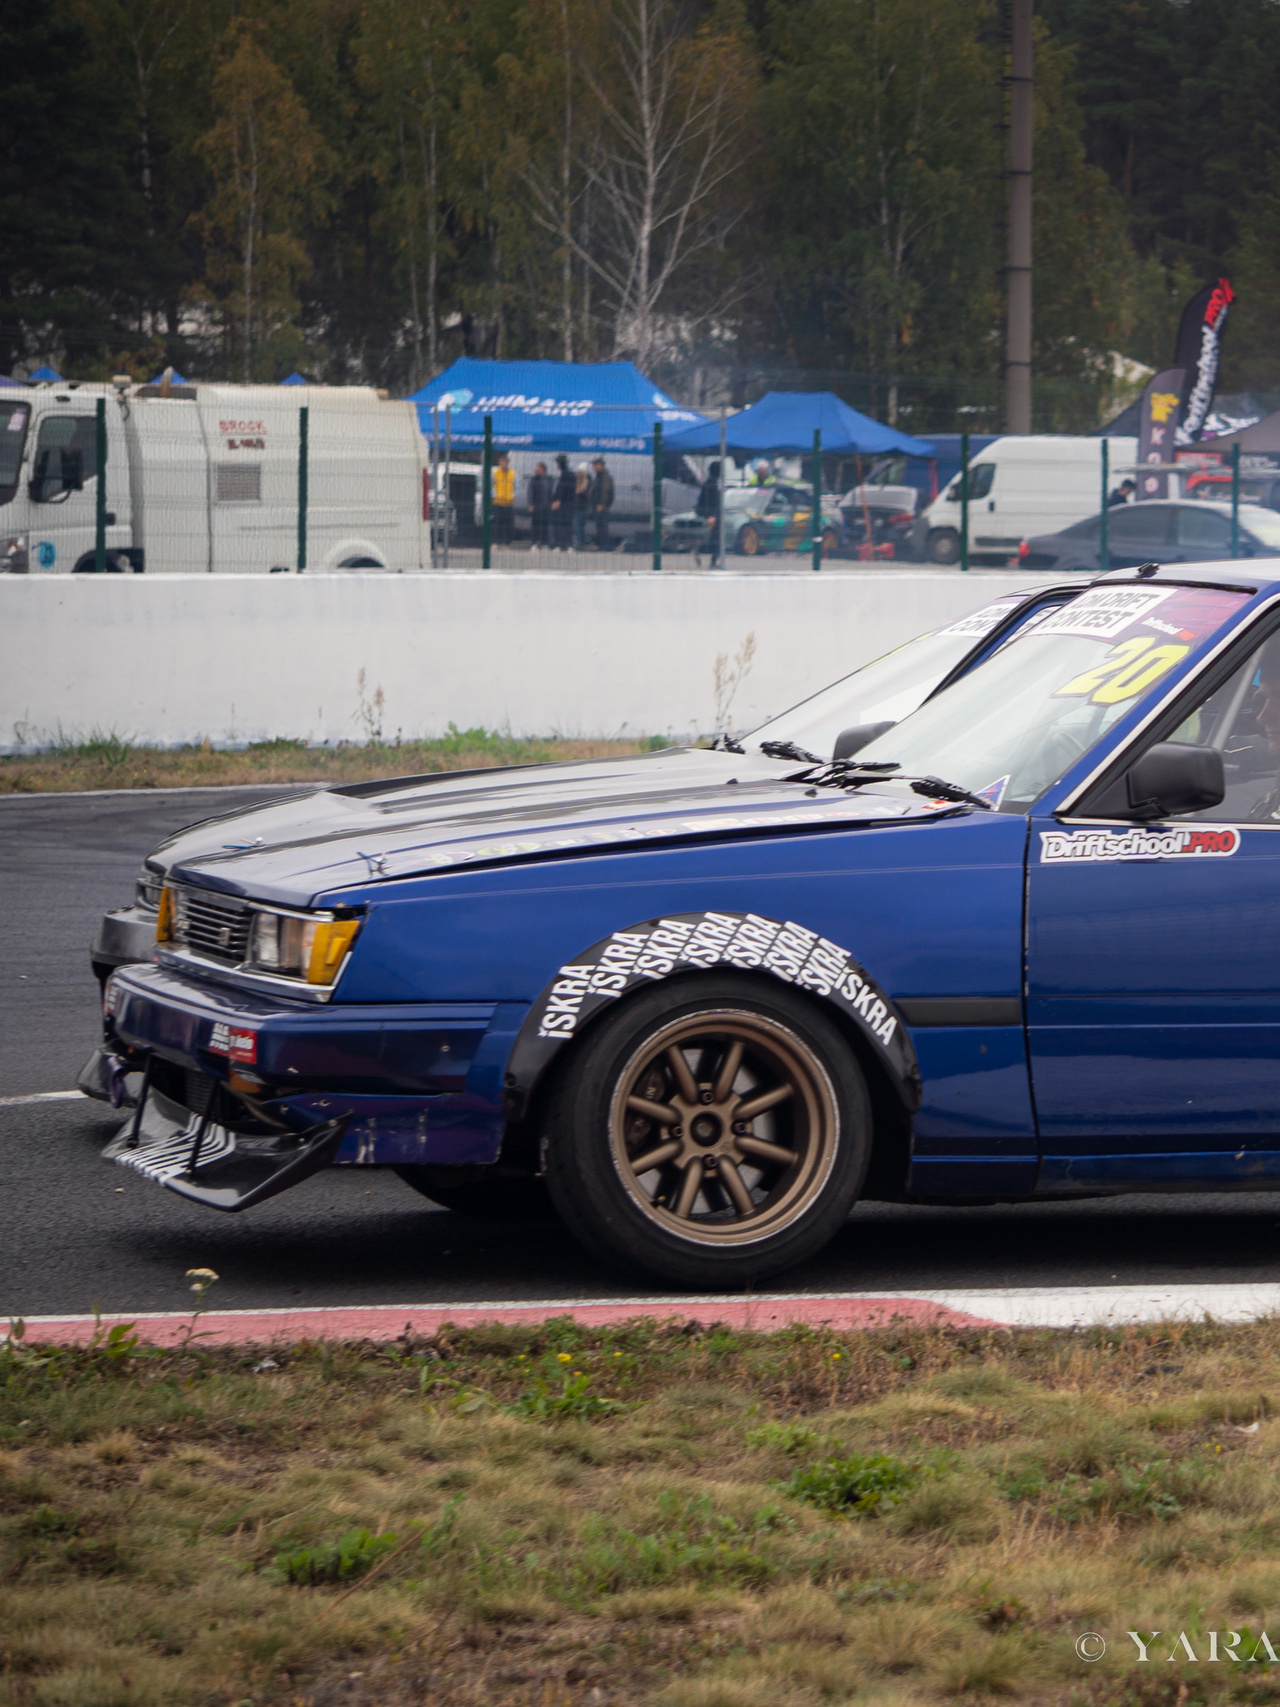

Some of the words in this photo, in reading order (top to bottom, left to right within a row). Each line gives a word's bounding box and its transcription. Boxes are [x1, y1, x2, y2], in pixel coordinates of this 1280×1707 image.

[1101, 592, 1161, 610] DRIFT
[1041, 609, 1136, 629] CONTEST
[1051, 635, 1193, 705] 20
